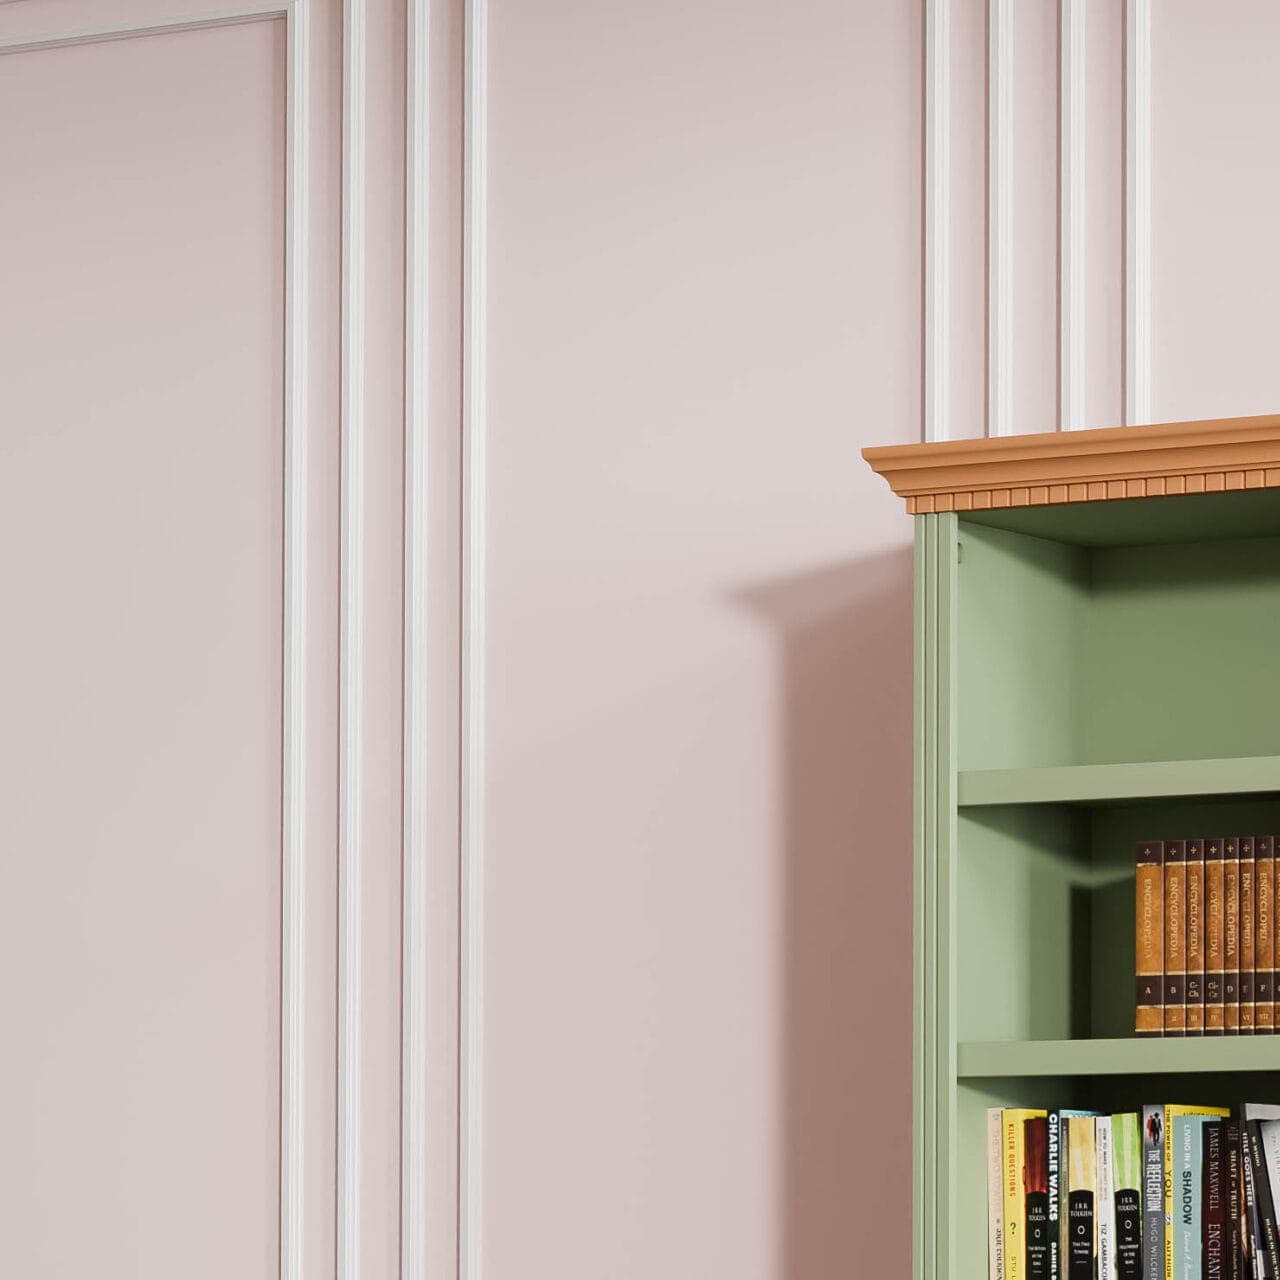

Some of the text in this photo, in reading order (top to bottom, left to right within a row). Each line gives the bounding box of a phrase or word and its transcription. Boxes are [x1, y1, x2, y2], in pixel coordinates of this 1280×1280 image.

[1144, 878, 1152, 958] ENCYCLOPEDIA
[1170, 877, 1178, 958] ENCYCLOPEDIA
[1190, 875, 1198, 957] ENCYCLOPEDIA
[1210, 876, 1218, 958] CYCLEDIA
[1227, 874, 1236, 956] ECYCLOPEDIA
[1242, 872, 1250, 953] ENCCLOPED
[1260, 872, 1268, 951] ENCYCLOPED
[1170, 986, 1176, 994] B
[1008, 1124, 1016, 1150] KILLER
[1048, 1114, 1059, 1222] CHARLIE WALKS
[1166, 1152, 1171, 1162] OF
[1184, 1124, 1192, 1150] LIVING
[1184, 1152, 1191, 1162] IN
[1208, 1128, 1220, 1210] JAMES MAXWELL
[1230, 1150, 1238, 1178] SHAFT
[1146, 1150, 1162, 1212] THE REFLECTION
[1182, 1171, 1192, 1224] SHADOW
[1266, 1218, 1274, 1240] BLACK
[1270, 1242, 1275, 1250] IN
